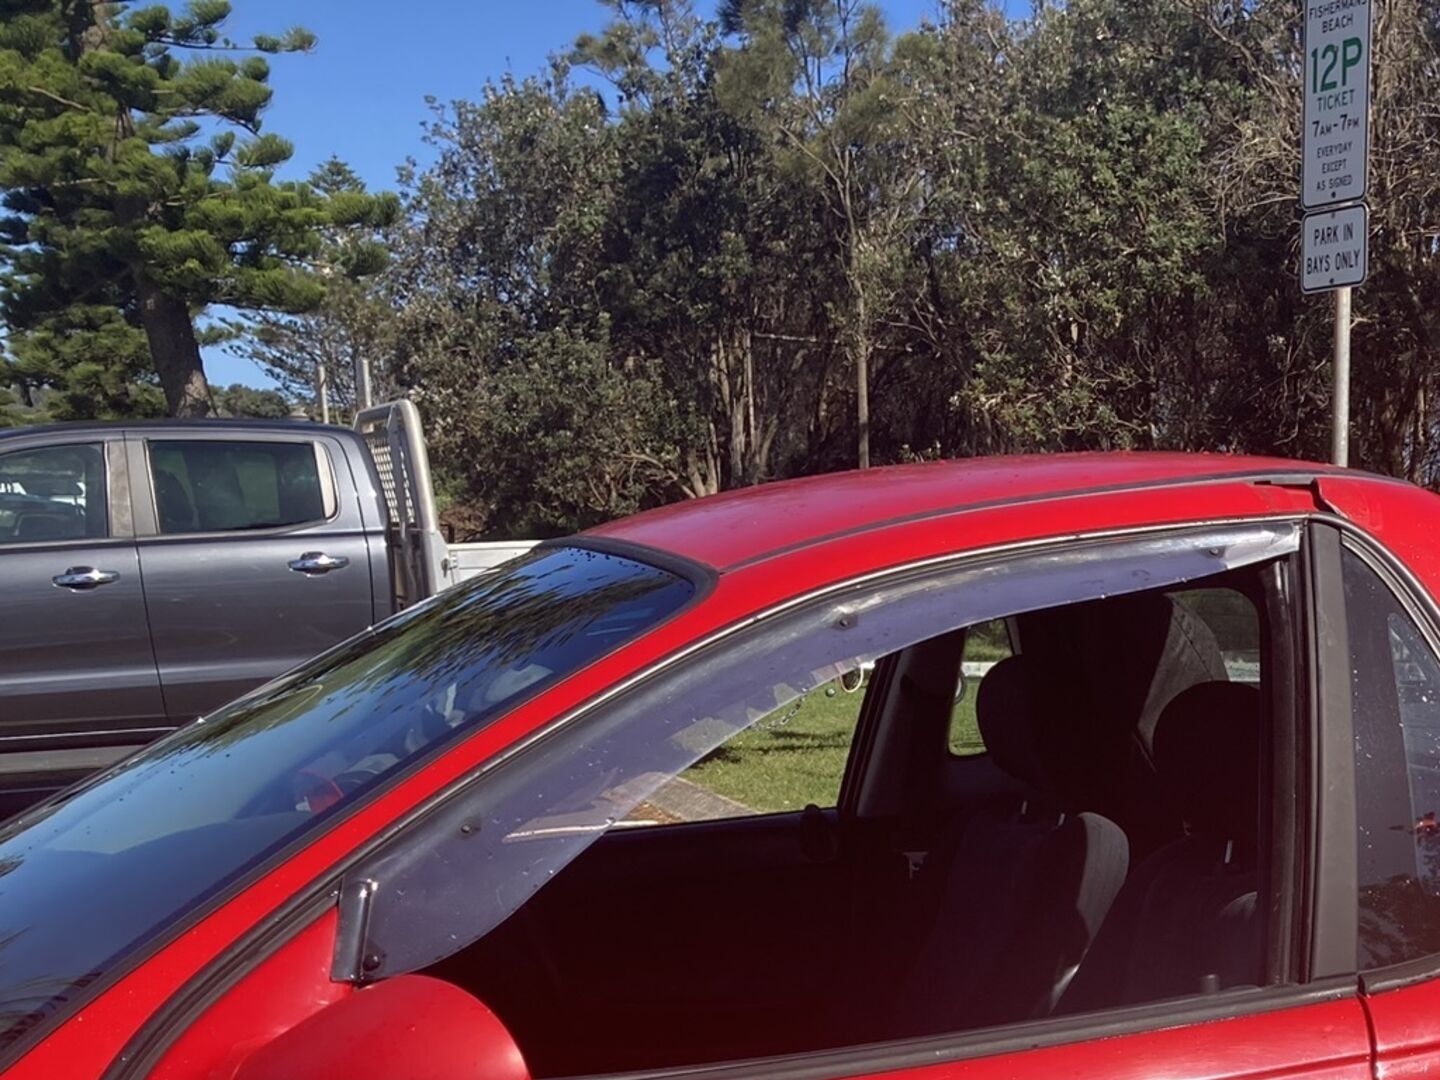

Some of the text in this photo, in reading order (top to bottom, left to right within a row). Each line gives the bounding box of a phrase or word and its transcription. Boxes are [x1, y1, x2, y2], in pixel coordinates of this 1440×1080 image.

[1322, 13, 1353, 34] BEACH
[1311, 36, 1363, 94] 12P
[1317, 88, 1355, 112] TICKET
[1317, 141, 1353, 158] EVERYDAY
[1321, 158, 1347, 174] EXCEPT
[1316, 180, 1326, 191] AS
[1313, 222, 1354, 247] PARK IN
[1306, 248, 1360, 276] BAYS ONLY
